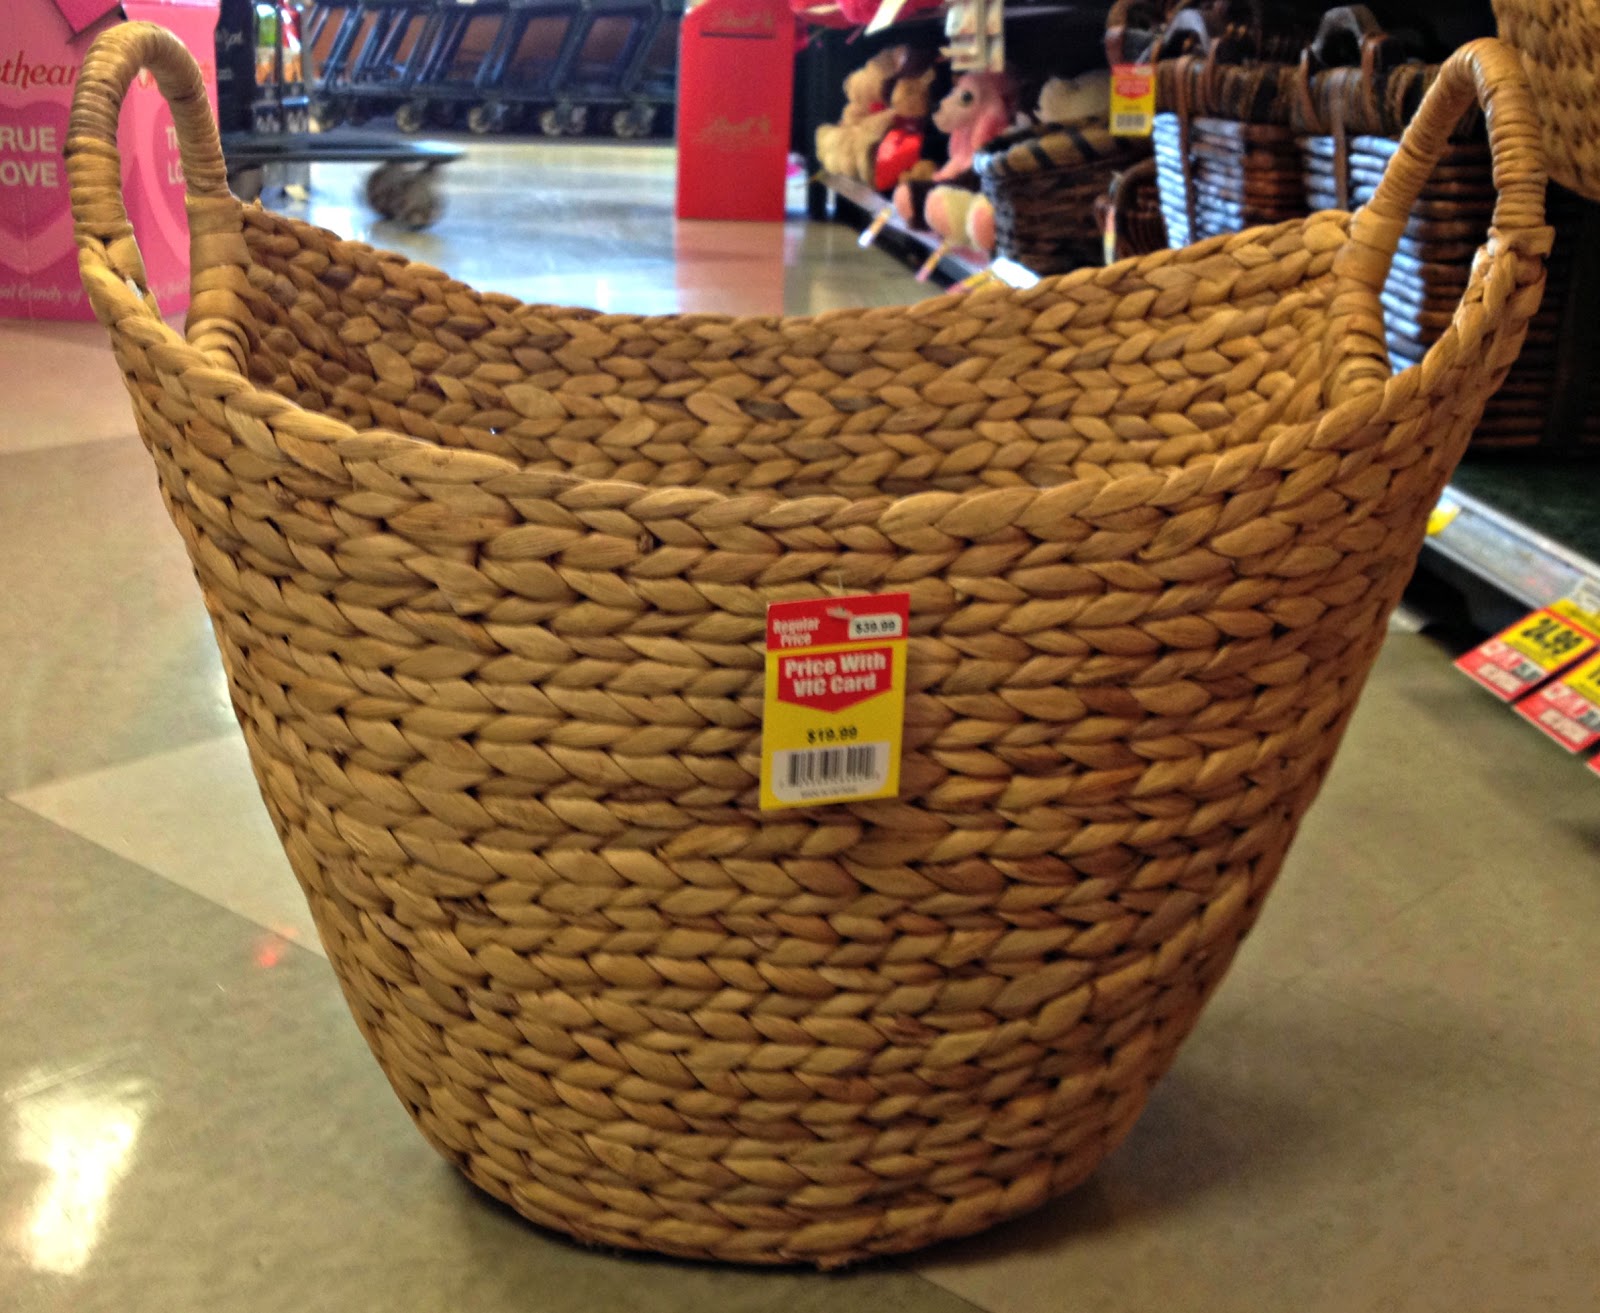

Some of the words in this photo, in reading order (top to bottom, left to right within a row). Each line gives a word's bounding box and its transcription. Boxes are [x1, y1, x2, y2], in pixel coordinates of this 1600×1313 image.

[773, 617, 820, 635] Regular
[780, 632, 812, 648] Price
[784, 657, 836, 679] Price
[840, 651, 886, 674] With
[830, 671, 877, 694] Card
